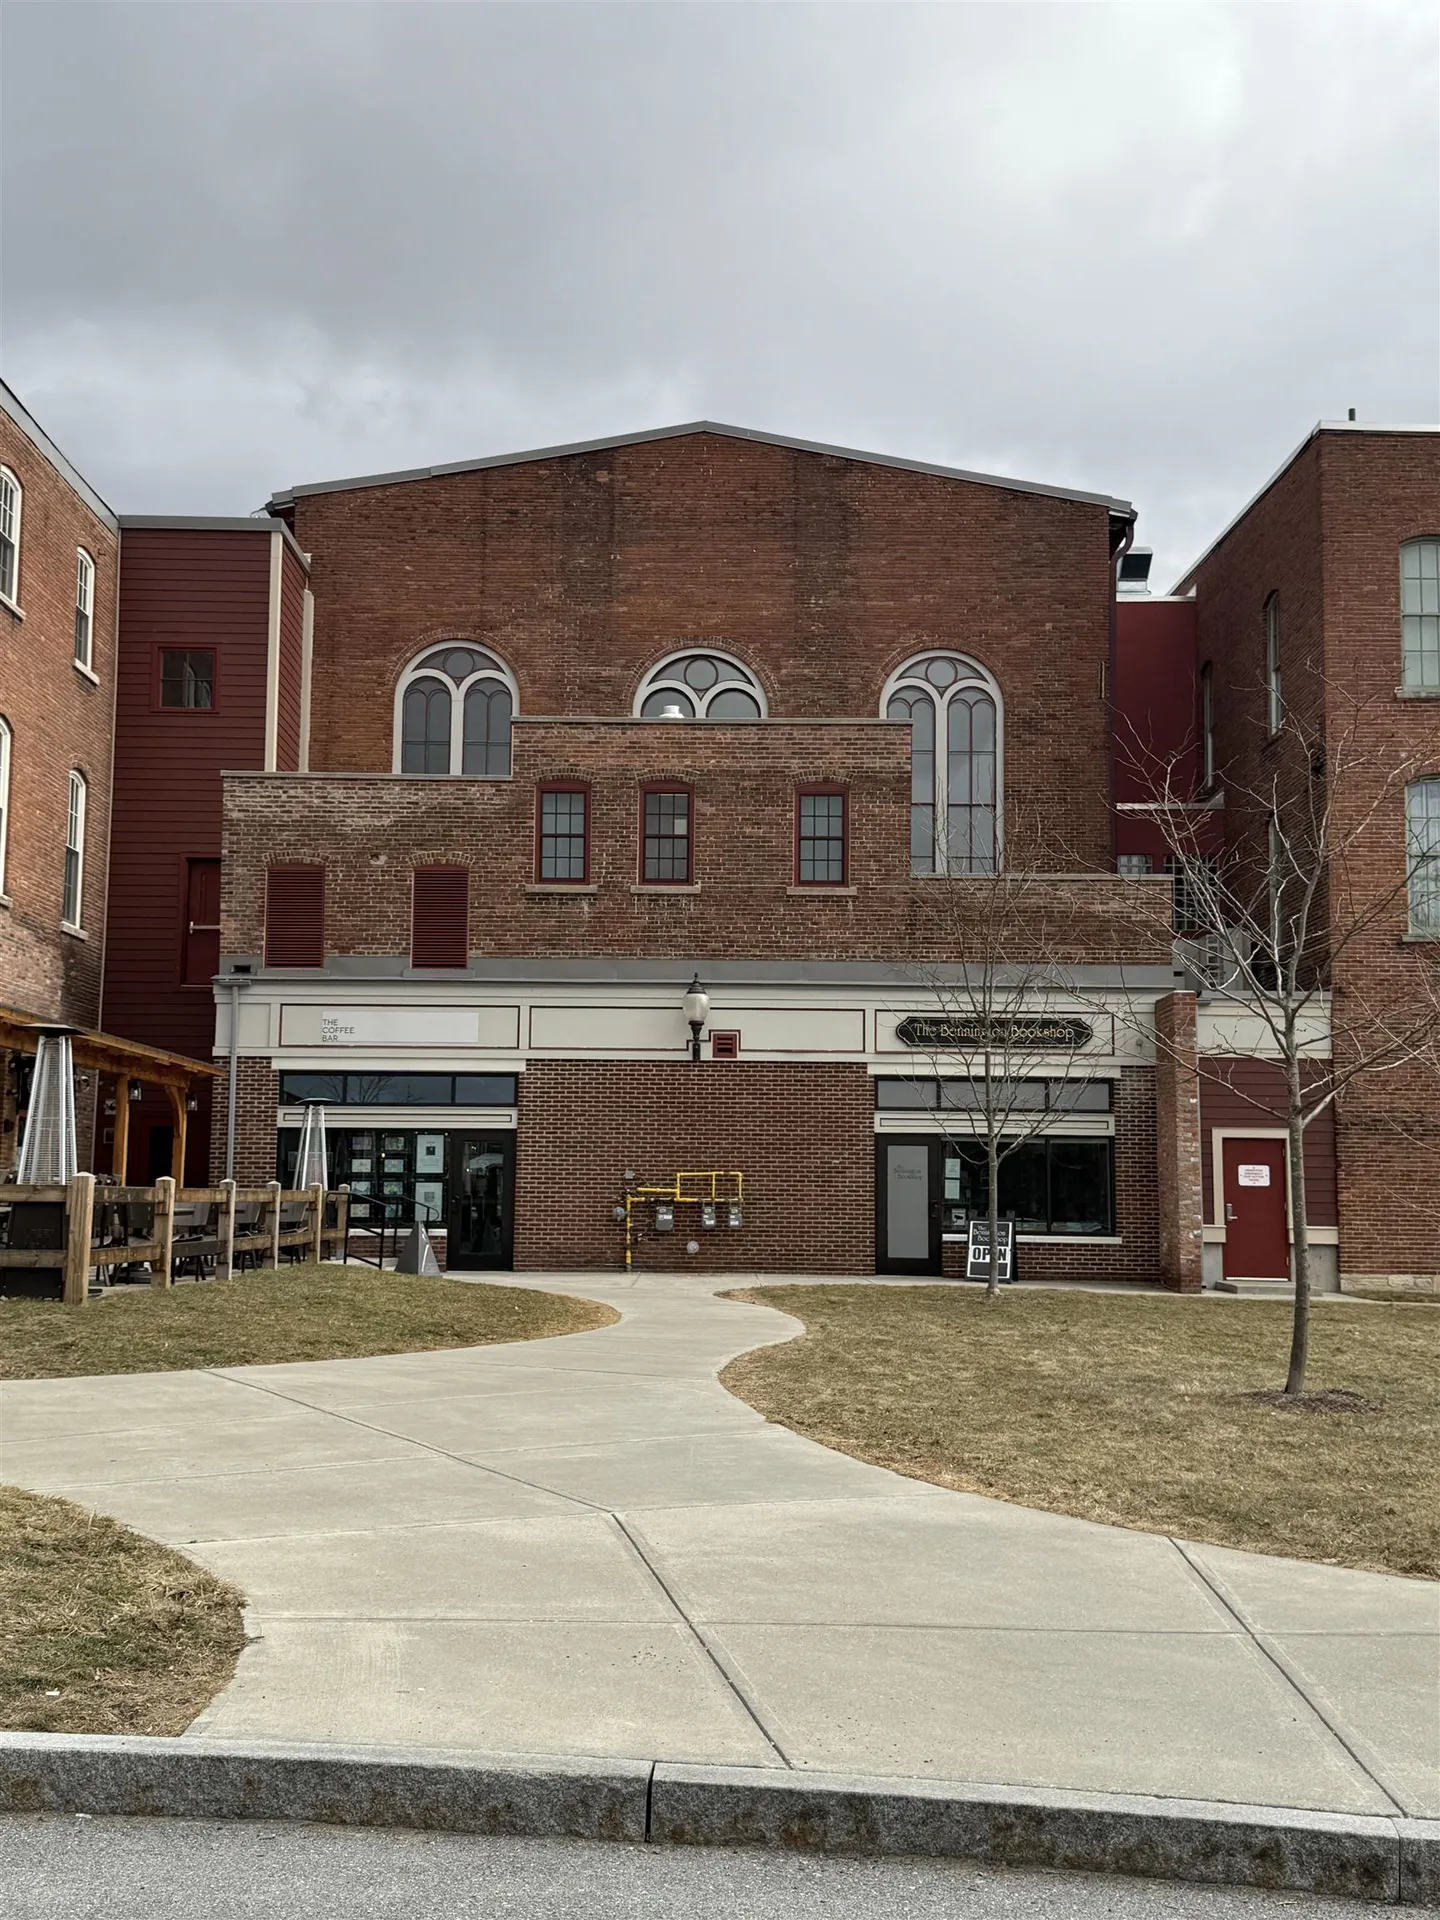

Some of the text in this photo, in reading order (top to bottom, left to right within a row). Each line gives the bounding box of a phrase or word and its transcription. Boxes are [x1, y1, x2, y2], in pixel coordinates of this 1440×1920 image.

[322, 1018, 338, 1026] THE
[322, 1026, 355, 1034] COFFEE
[913, 1023, 1074, 1042] The Benningon Bookshop
[322, 1034, 339, 1042] BAR
[973, 1246, 1007, 1262] OPN
